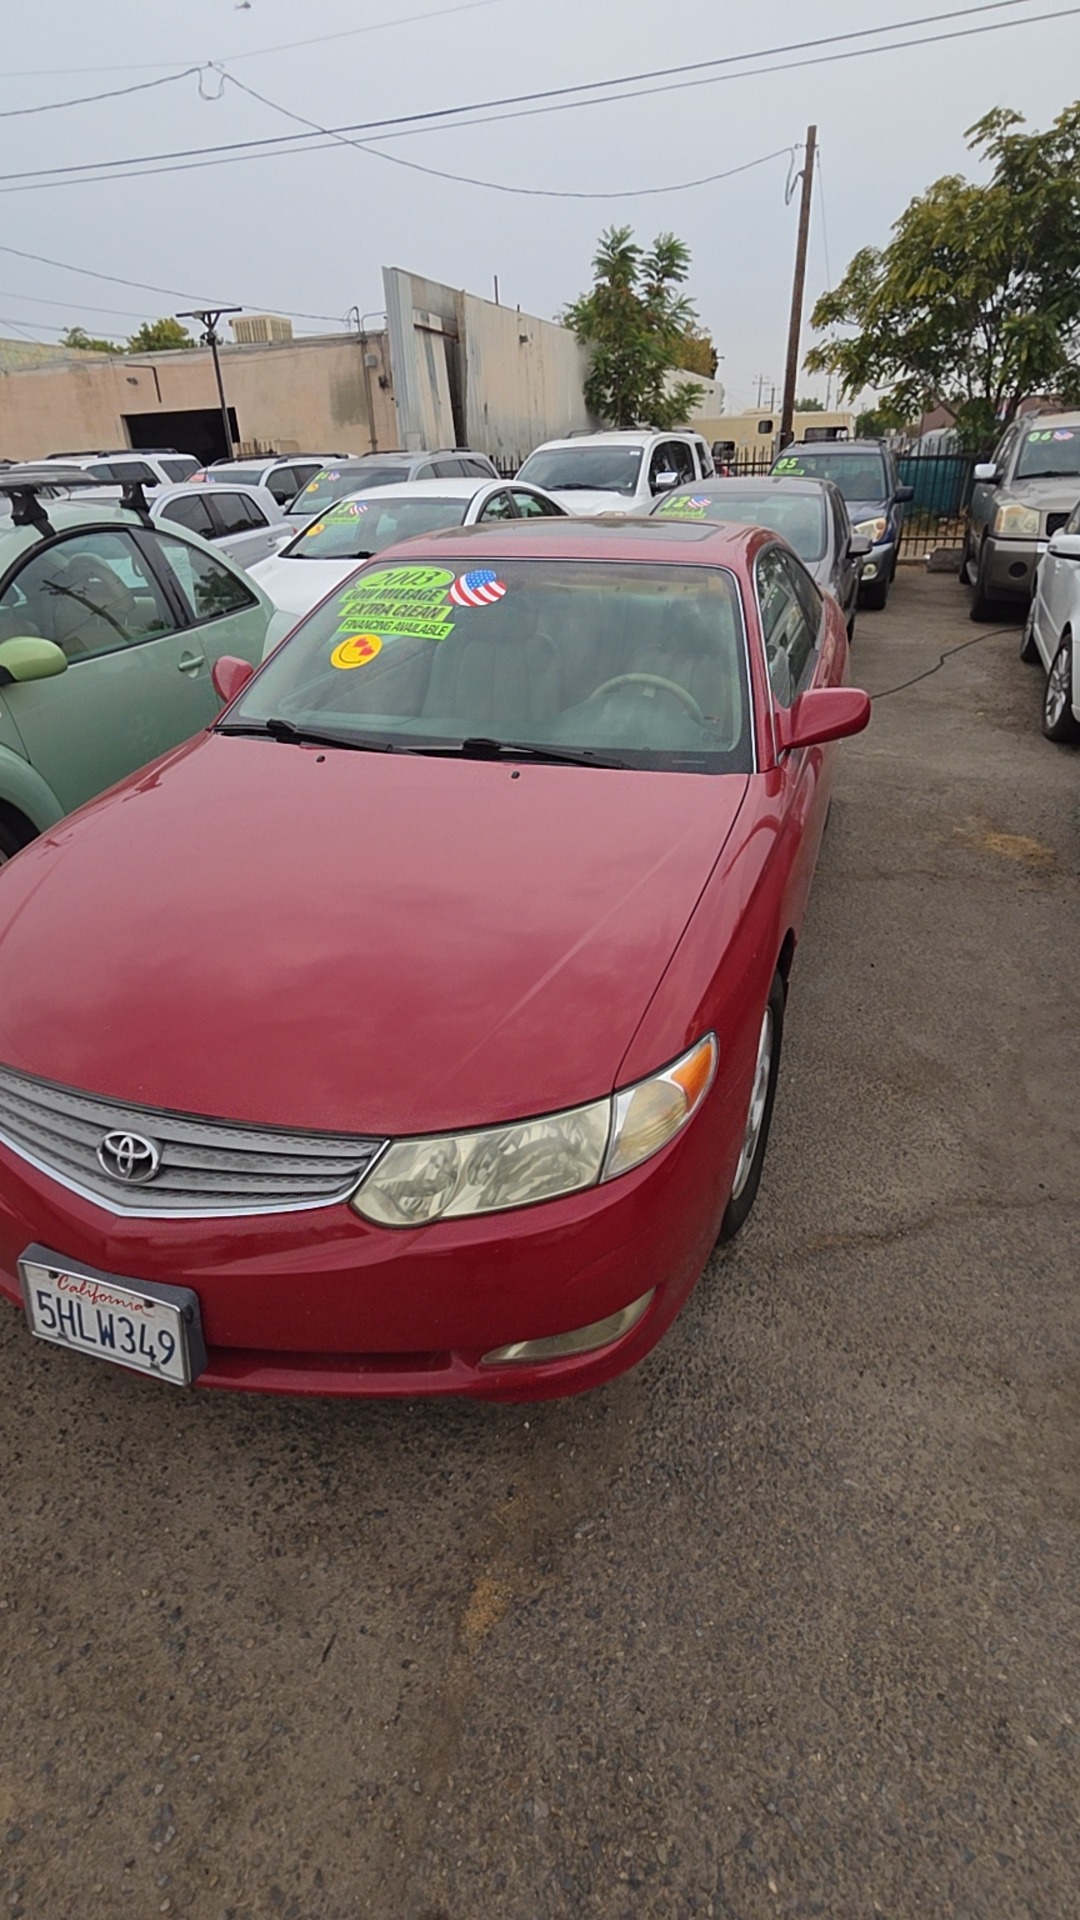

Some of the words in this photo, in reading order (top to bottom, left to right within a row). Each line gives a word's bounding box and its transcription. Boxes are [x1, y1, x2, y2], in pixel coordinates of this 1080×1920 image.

[1028, 431, 1052, 442] 06
[777, 458, 799, 469] 05
[665, 496, 691, 508] 12
[366, 571, 442, 587] 2003
[373, 588, 442, 602] MILEAGE
[347, 603, 393, 615] EXTRA
[392, 605, 443, 619] CLEAN
[340, 619, 393, 631] FINANCING
[392, 622, 449, 637] AVAILABLE
[57, 1274, 155, 1319] California
[36, 1290, 175, 1365] 5HLW349
